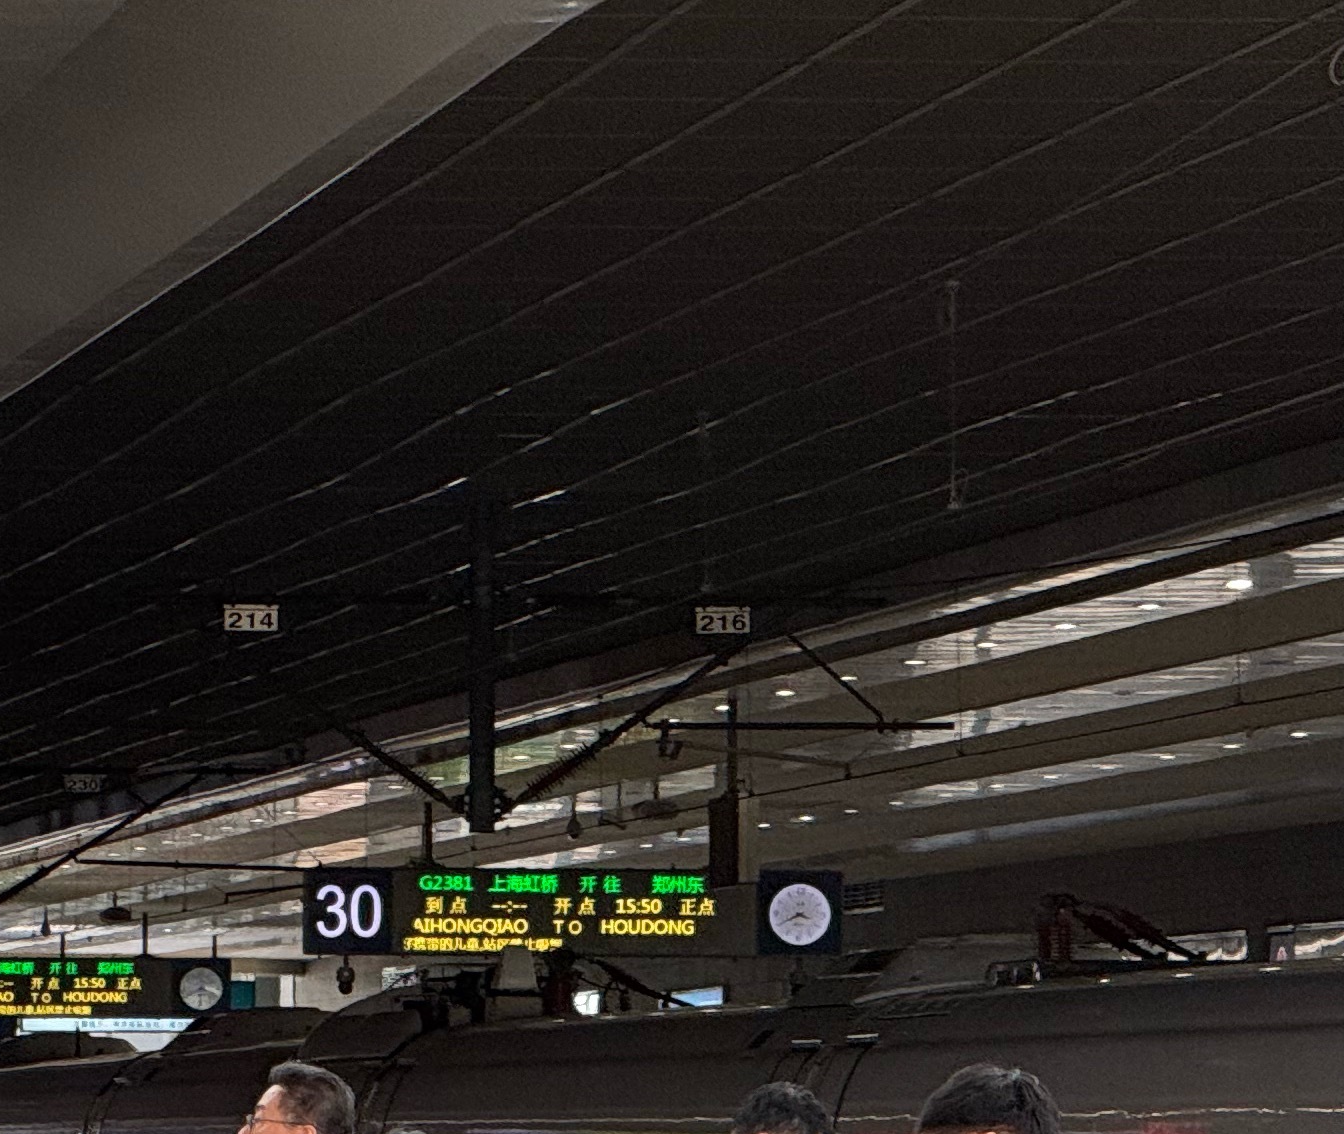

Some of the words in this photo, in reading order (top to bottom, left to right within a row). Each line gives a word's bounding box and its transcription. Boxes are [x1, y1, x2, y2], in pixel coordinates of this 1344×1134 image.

[227, 612, 274, 629] 214
[700, 613, 746, 631] 216
[419, 875, 473, 891] G2381
[488, 875, 558, 892] 上海虹桥
[579, 875, 622, 894] 开往
[651, 875, 705, 893] 郑州东
[315, 883, 383, 939] 30
[425, 896, 468, 914] 到点
[553, 898, 596, 915] 开点
[616, 898, 662, 914] 15:50
[678, 898, 716, 916] 正点
[413, 917, 529, 936] AIHONGQIAO
[552, 919, 583, 935] TO
[600, 919, 695, 936] HOUDONG
[73, 978, 107, 990] 15:50
[31, 992, 52, 1004] TO
[62, 992, 128, 1004] HOUDONG
